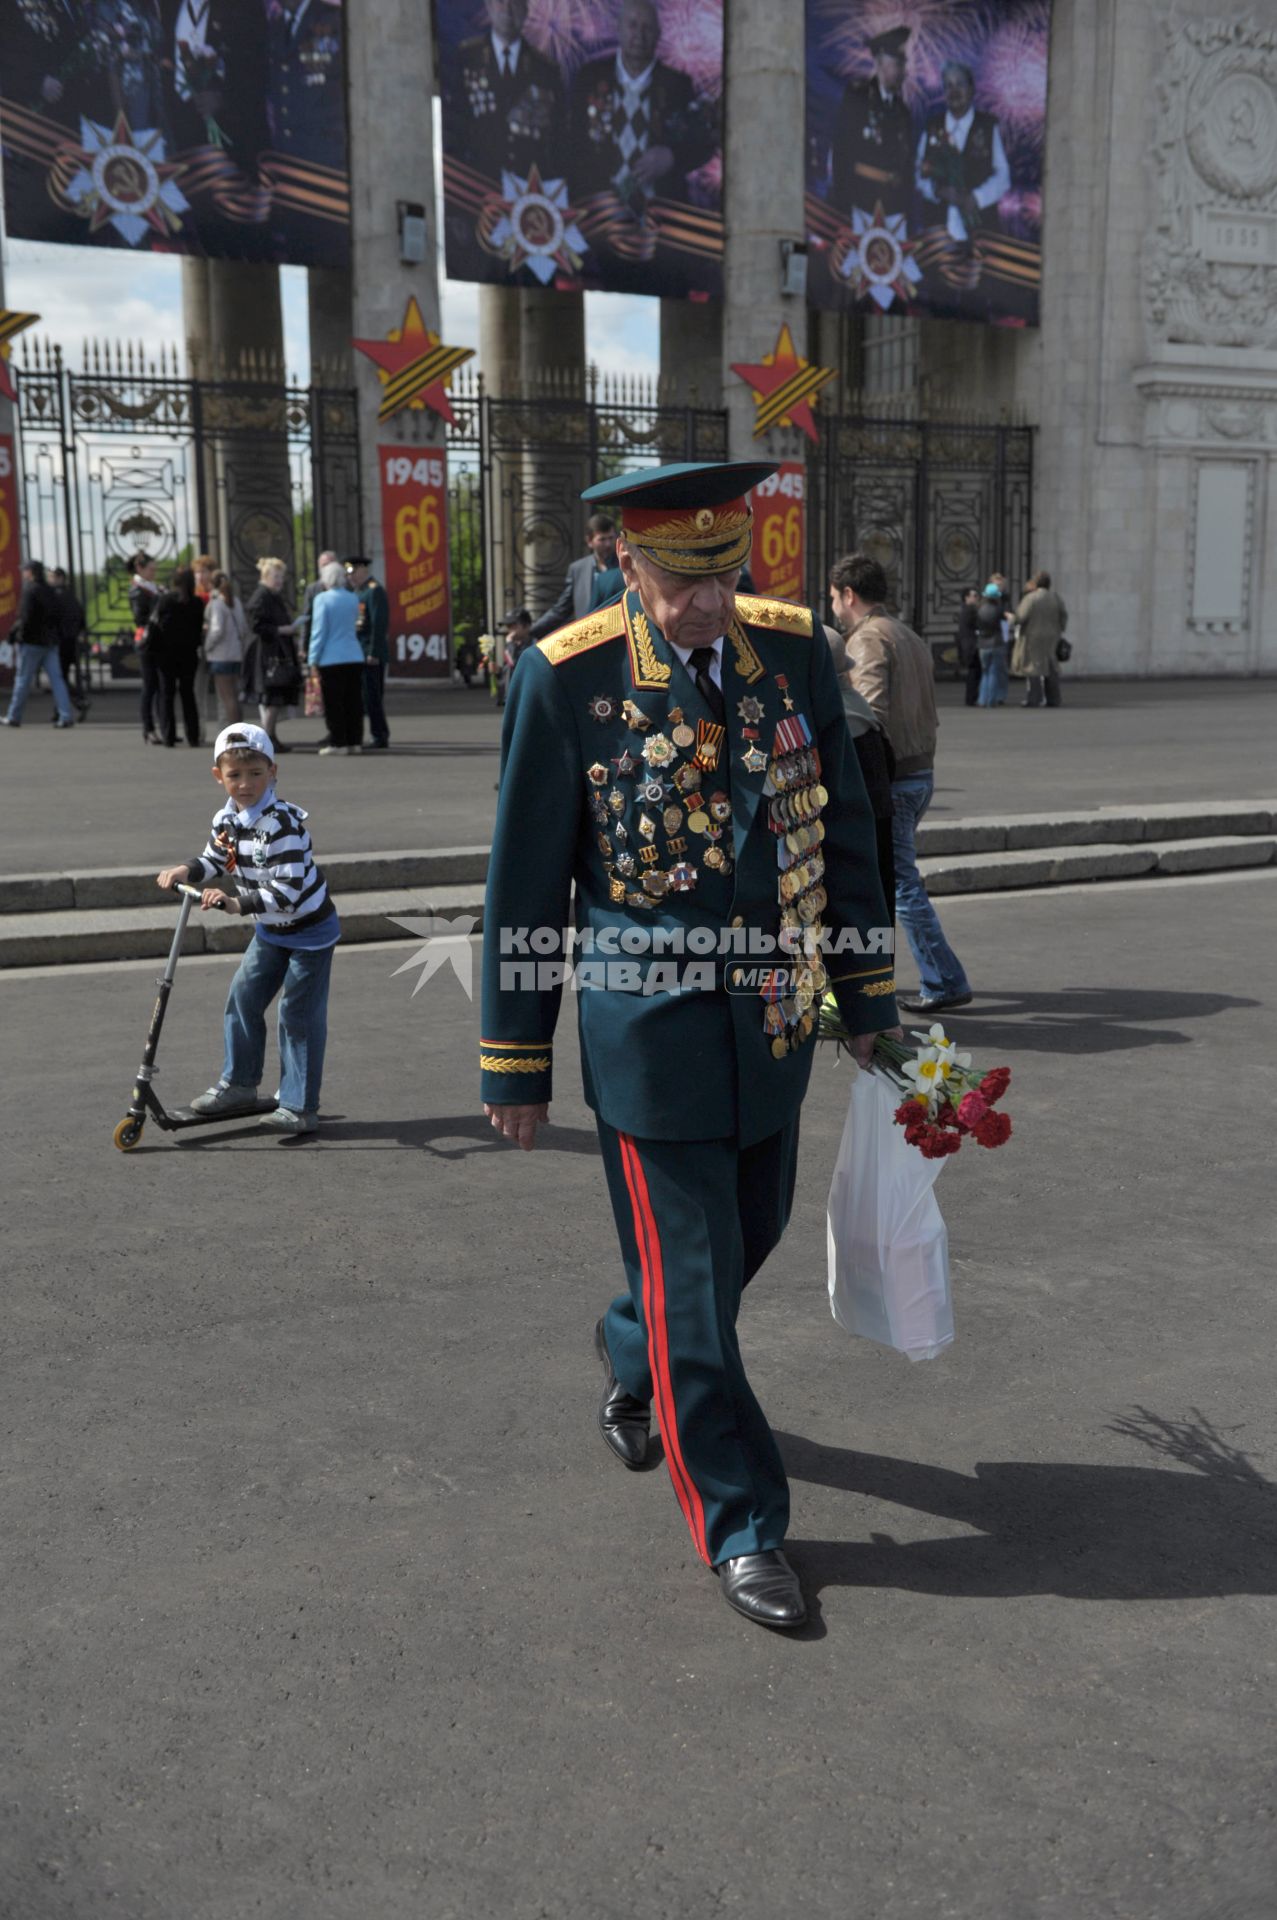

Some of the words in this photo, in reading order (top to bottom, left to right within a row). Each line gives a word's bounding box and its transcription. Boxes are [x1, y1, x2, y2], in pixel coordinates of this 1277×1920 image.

[385, 457, 443, 487] 1945
[395, 495, 440, 564] 66
[761, 506, 800, 567] 66
[396, 633, 447, 661] 1941
